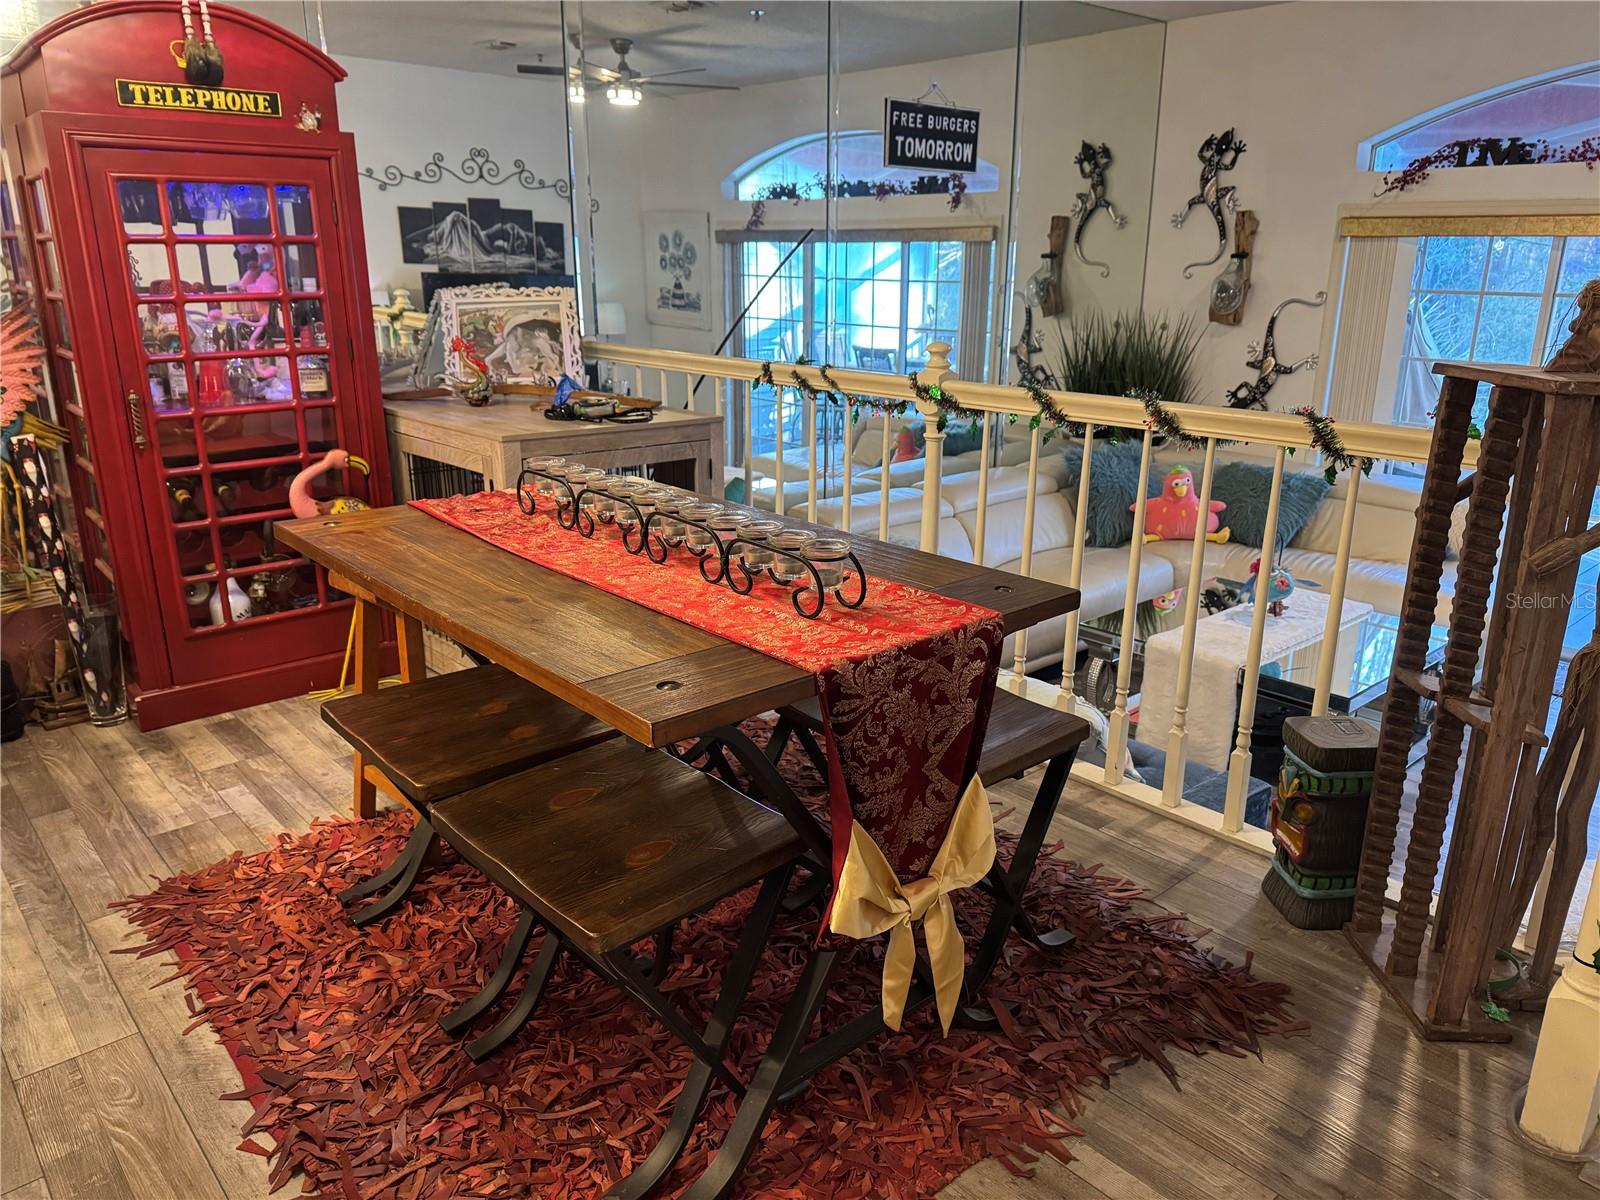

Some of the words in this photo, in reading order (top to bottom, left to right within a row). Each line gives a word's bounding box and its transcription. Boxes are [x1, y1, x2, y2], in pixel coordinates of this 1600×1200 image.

[128, 83, 272, 114] TELEPHONE
[892, 110, 924, 129] FREE
[927, 114, 977, 134] BURGERS
[895, 135, 973, 163] TOMORROW
